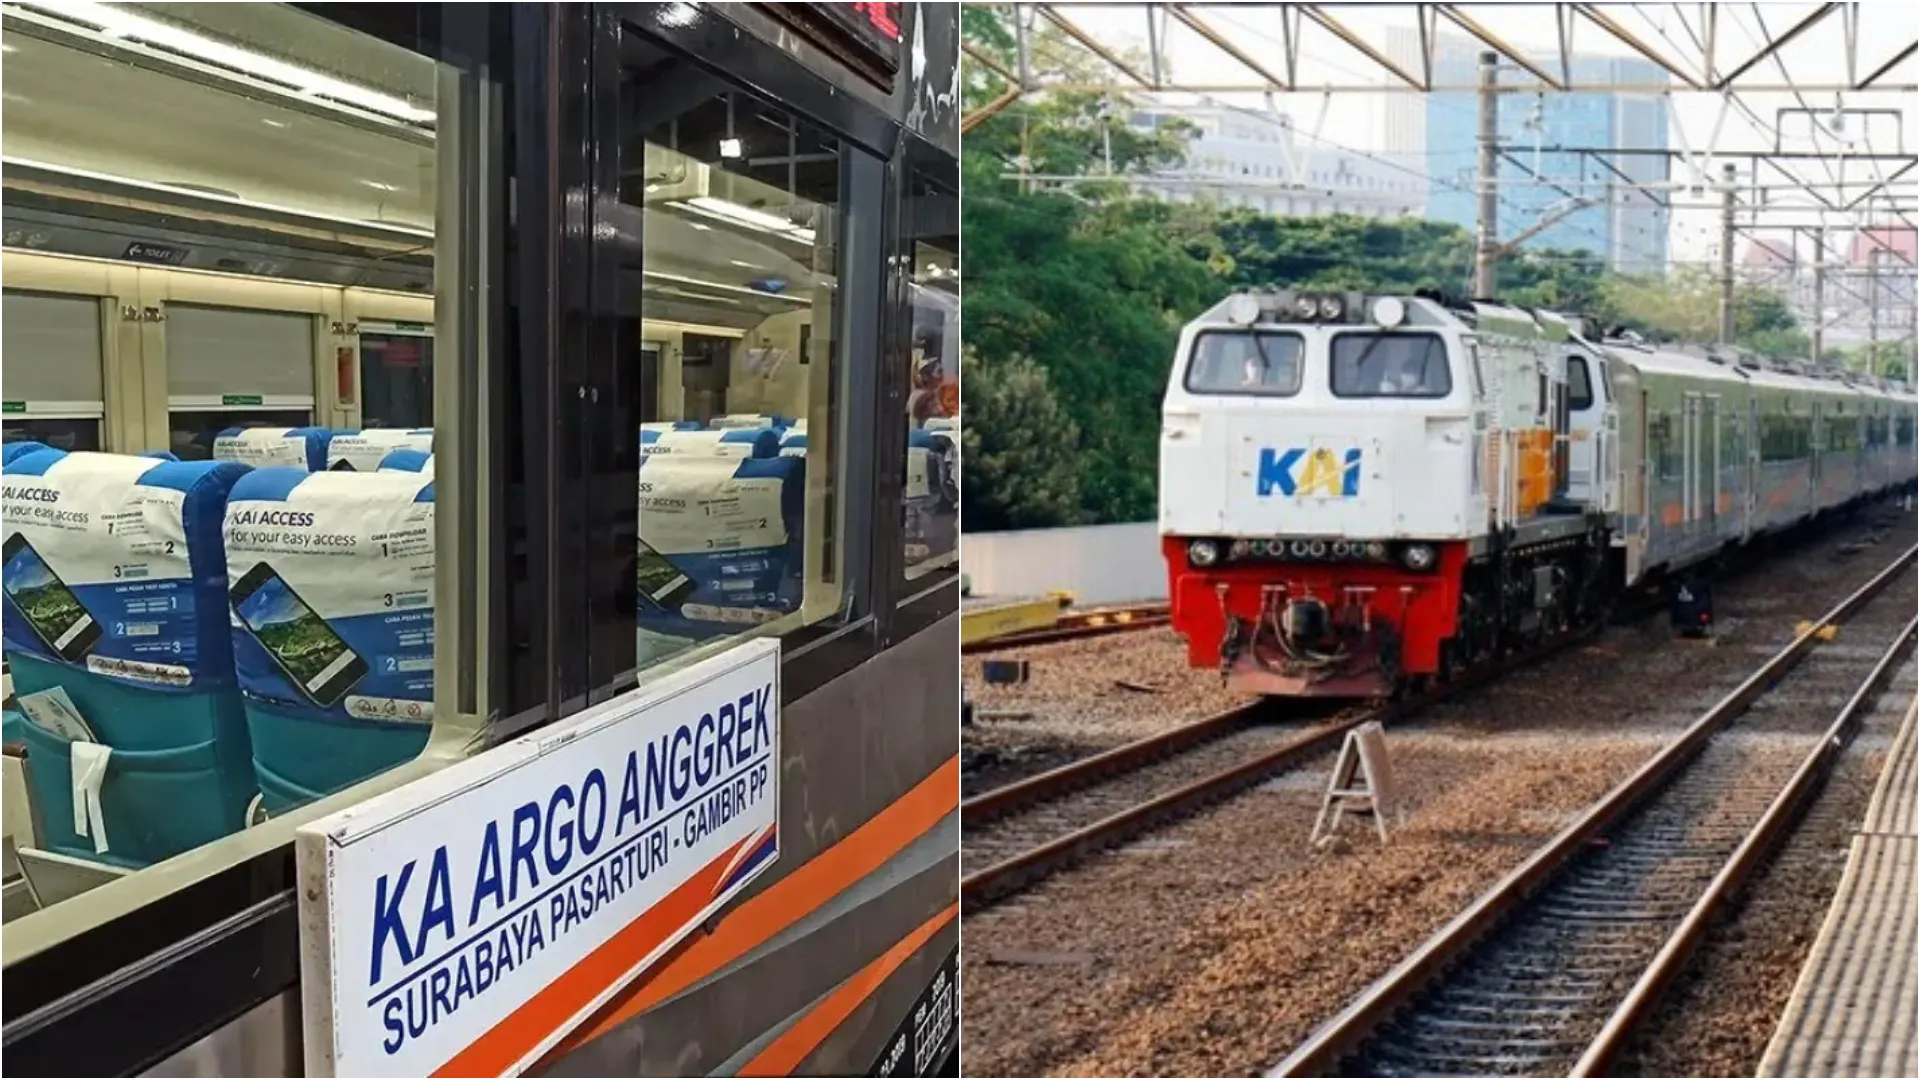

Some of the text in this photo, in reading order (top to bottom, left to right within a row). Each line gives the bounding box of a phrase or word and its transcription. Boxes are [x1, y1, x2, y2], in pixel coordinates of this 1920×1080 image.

[1258, 446, 1363, 496] KAI
[16, 487, 60, 503] ACCESS
[9, 504, 32, 517] your
[34, 506, 54, 522] easy
[55, 509, 90, 523] access
[230, 510, 314, 527] KAI ACCESS
[108, 523, 114, 535] 1
[758, 517, 767, 529] 2
[231, 528, 357, 548] for your easy access
[165, 541, 175, 554] 2
[381, 543, 388, 557] 1
[113, 565, 121, 578] 3
[171, 596, 177, 609] 1
[384, 593, 394, 607] 3
[116, 622, 124, 635] 2
[172, 641, 181, 653] 3
[385, 657, 396, 671] 2
[369, 845, 456, 987] KA
[469, 768, 607, 927] ARGO
[615, 683, 773, 837] ANGGREK
[383, 914, 545, 1055] SURABAYA
[550, 835, 669, 941] PASARTURI
[684, 782, 746, 848] GAMBIR
[750, 764, 768, 806] PP
